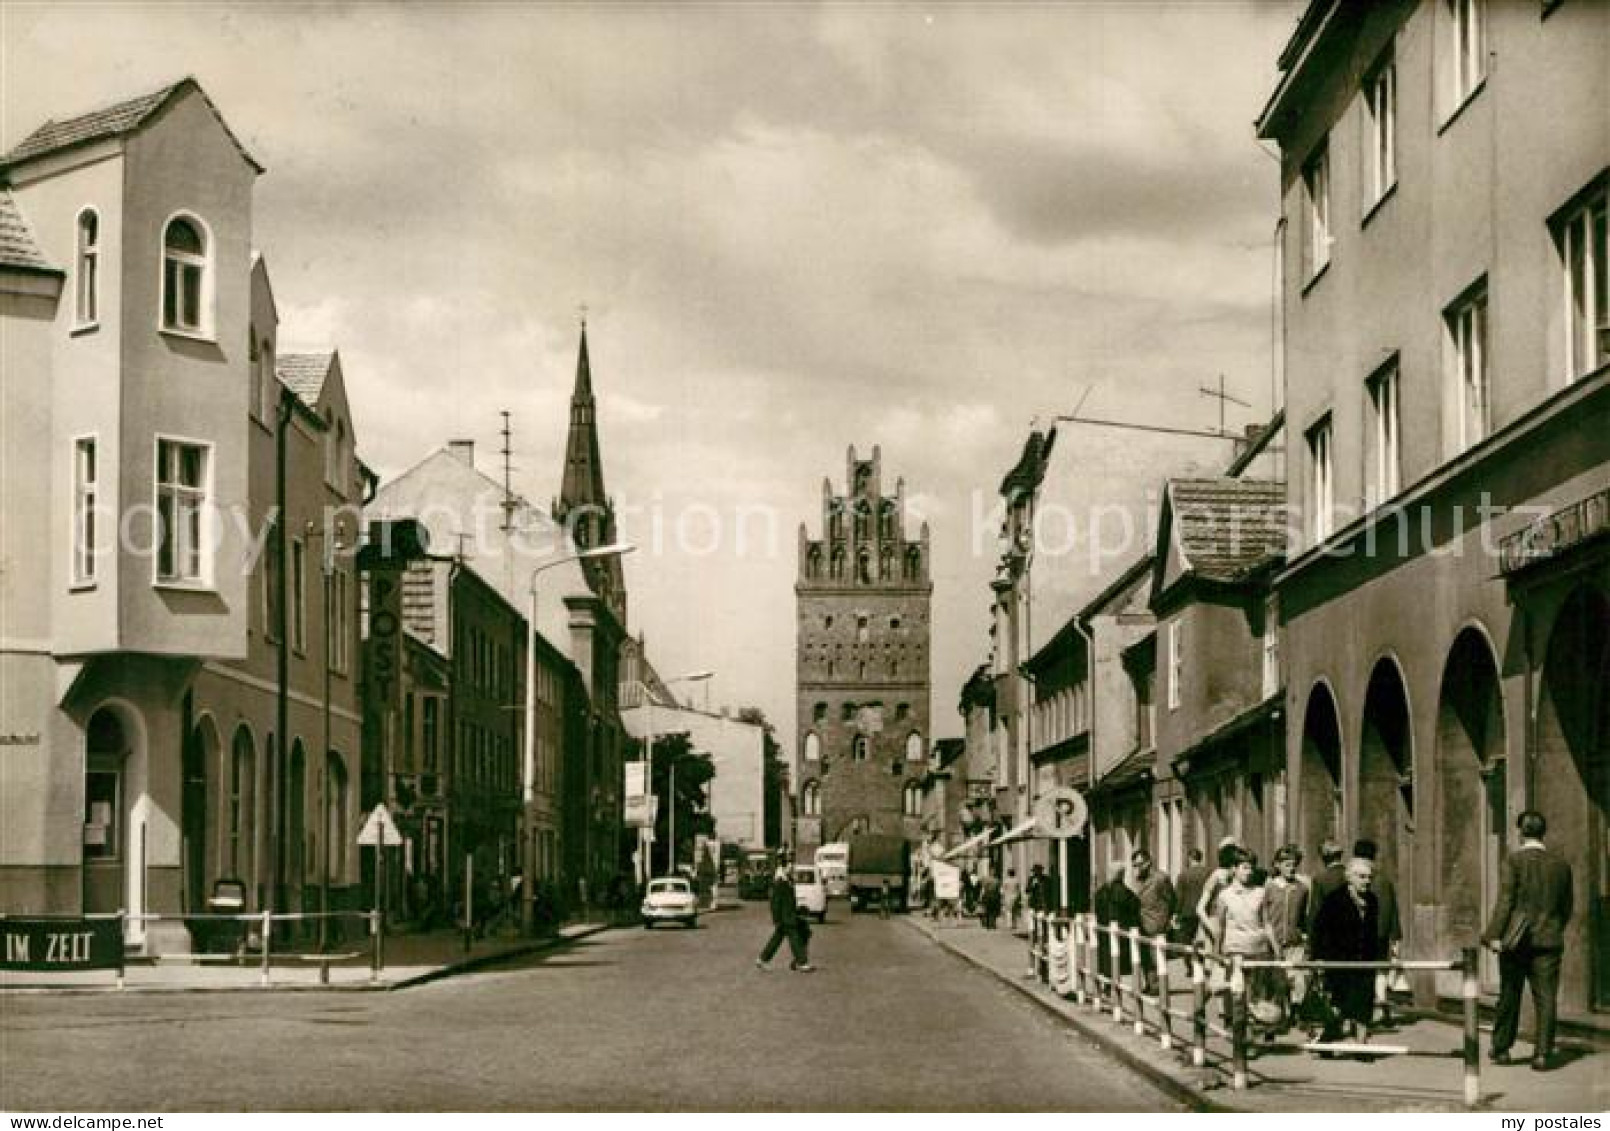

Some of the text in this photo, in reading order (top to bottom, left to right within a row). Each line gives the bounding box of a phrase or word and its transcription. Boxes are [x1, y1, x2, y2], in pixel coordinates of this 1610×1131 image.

[371, 578, 398, 702] POST
[1055, 798, 1074, 829] P
[6, 931, 95, 962] IM ZELT
